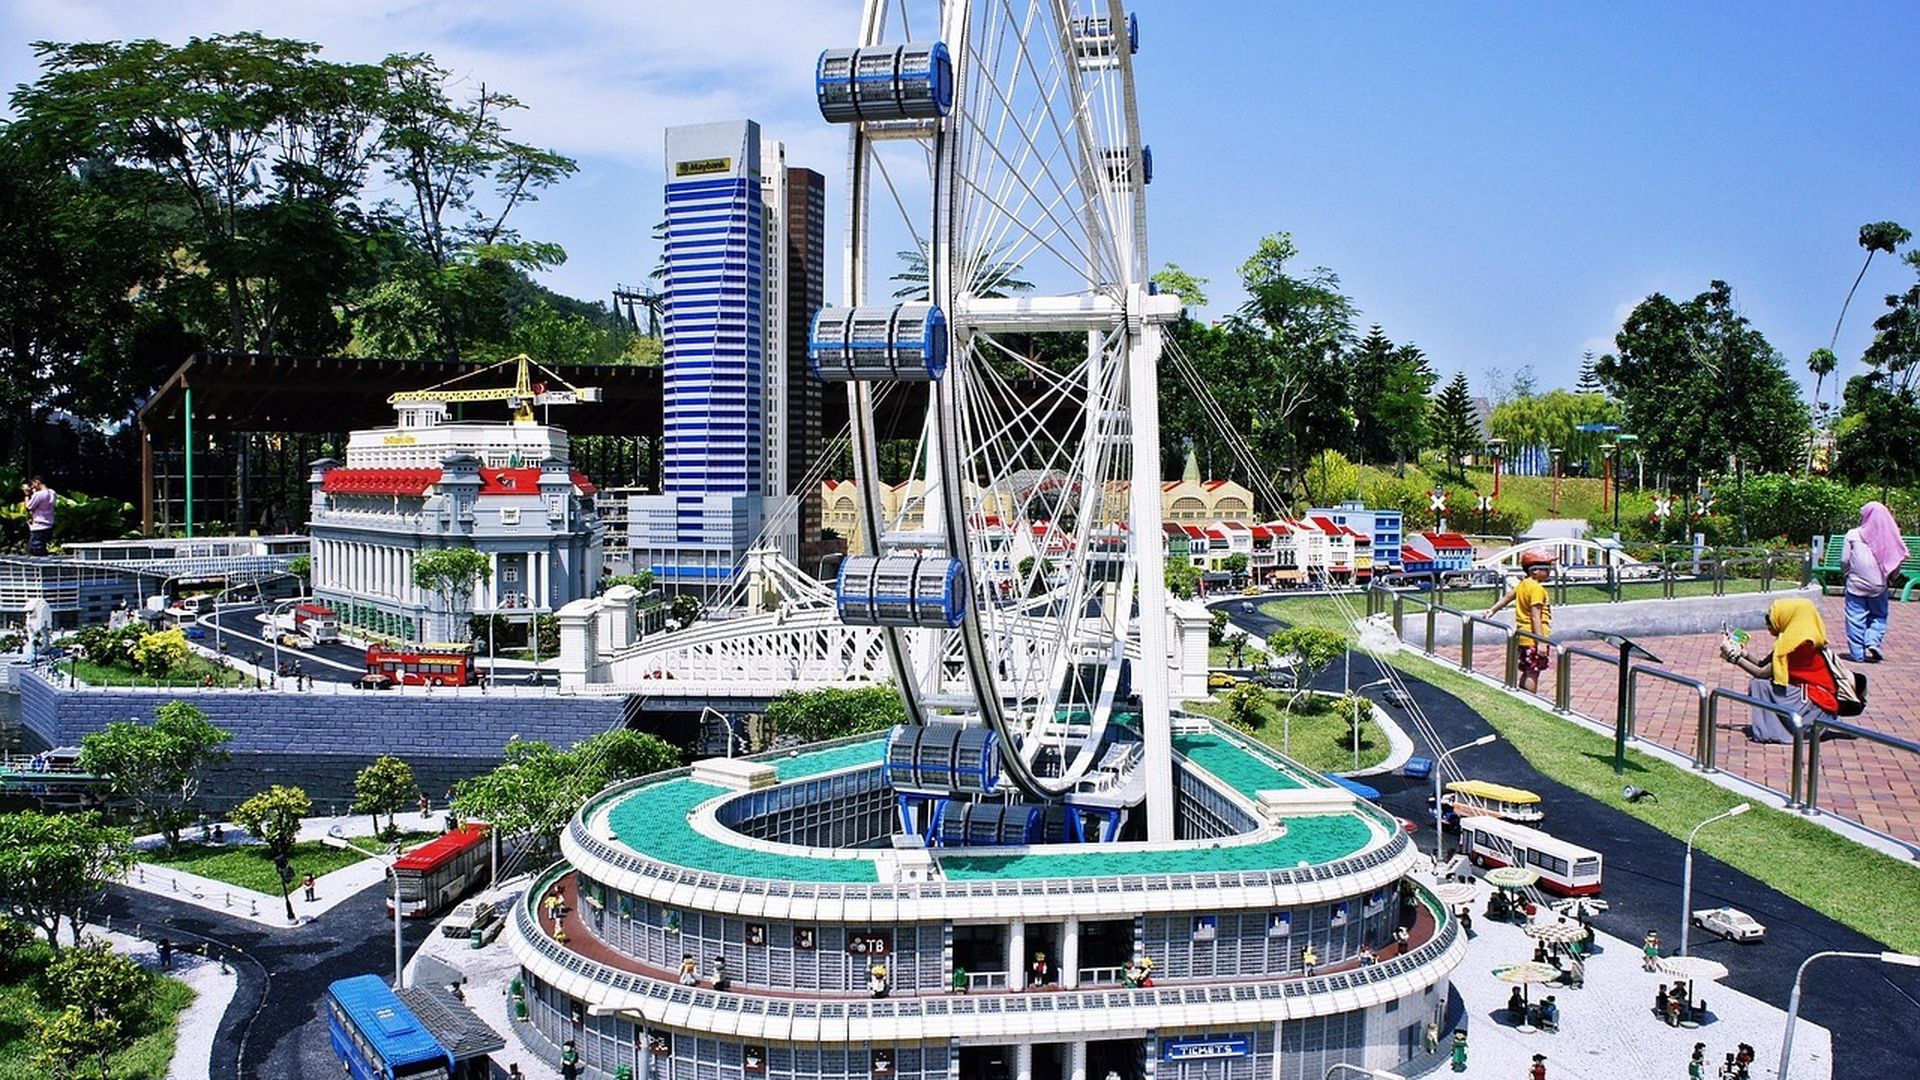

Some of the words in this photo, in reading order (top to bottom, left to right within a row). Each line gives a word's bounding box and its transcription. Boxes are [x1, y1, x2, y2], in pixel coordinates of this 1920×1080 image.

[690, 160, 725, 172] Maybank
[866, 939, 884, 953] TB
[1179, 1044, 1233, 1056] TICKETS
